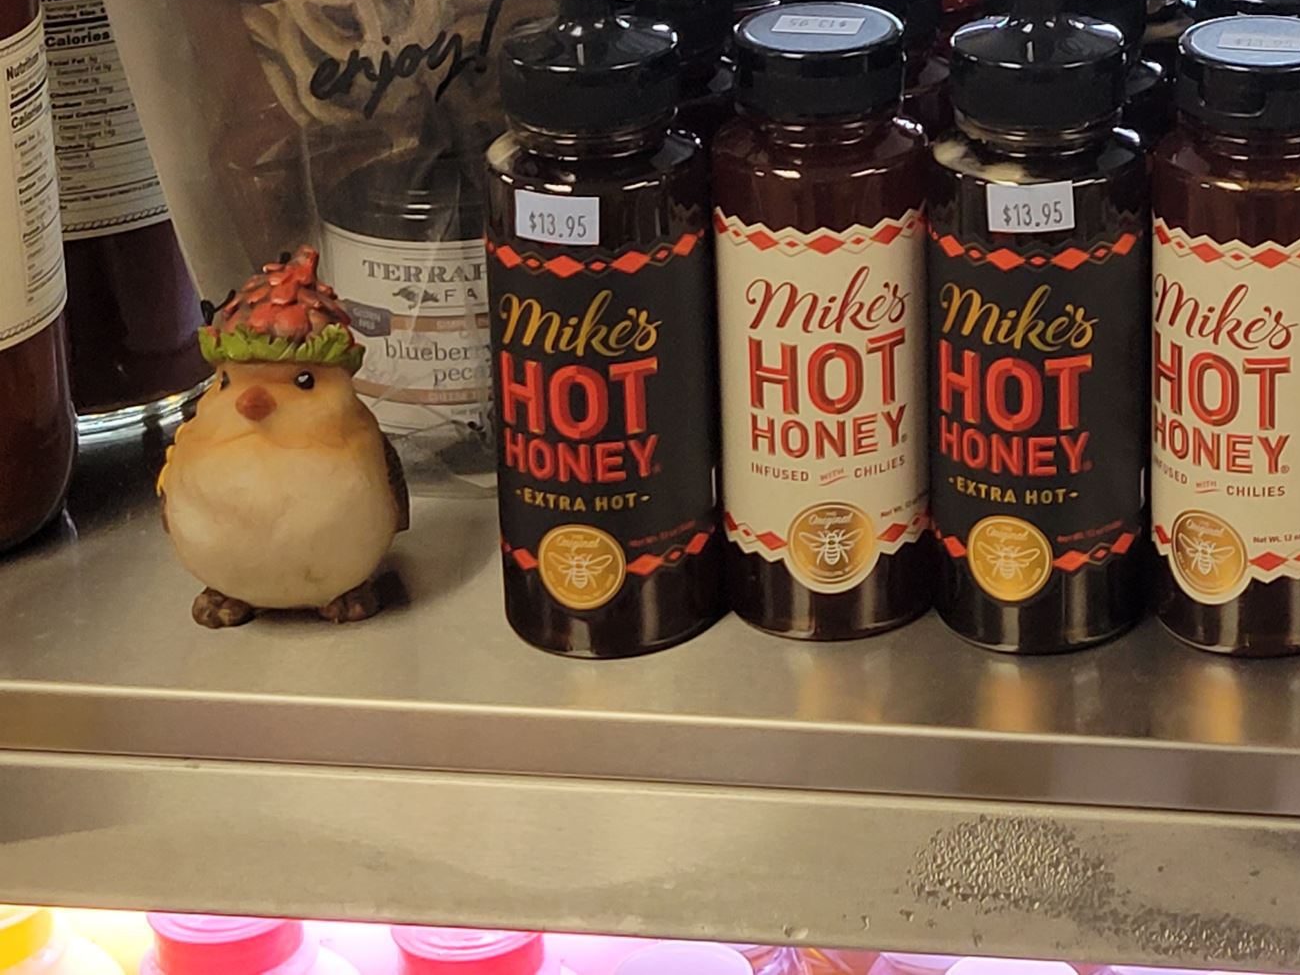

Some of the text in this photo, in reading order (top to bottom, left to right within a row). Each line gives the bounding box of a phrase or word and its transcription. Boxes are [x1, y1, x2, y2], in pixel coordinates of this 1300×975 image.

[45, 31, 111, 47] Calories
[529, 211, 588, 238] $13.95
[1003, 201, 1063, 227] $13.95
[501, 290, 662, 356] Mike's
[746, 266, 912, 333] Mike's
[940, 282, 1099, 351] Mike's
[1153, 272, 1299, 351] Mike's
[384, 336, 490, 362] blueber
[747, 328, 907, 415] HOT
[502, 351, 658, 439] HOT
[939, 339, 1093, 432] HOT
[1153, 332, 1291, 431] HOT
[504, 428, 658, 483] HONEY
[751, 405, 907, 459] HONEY
[941, 415, 1090, 477] HONEY
[1154, 411, 1290, 474] HONEY
[751, 462, 809, 482] INFUSED
[854, 455, 906, 478] CHILIES
[1226, 485, 1286, 497] CHILIES
